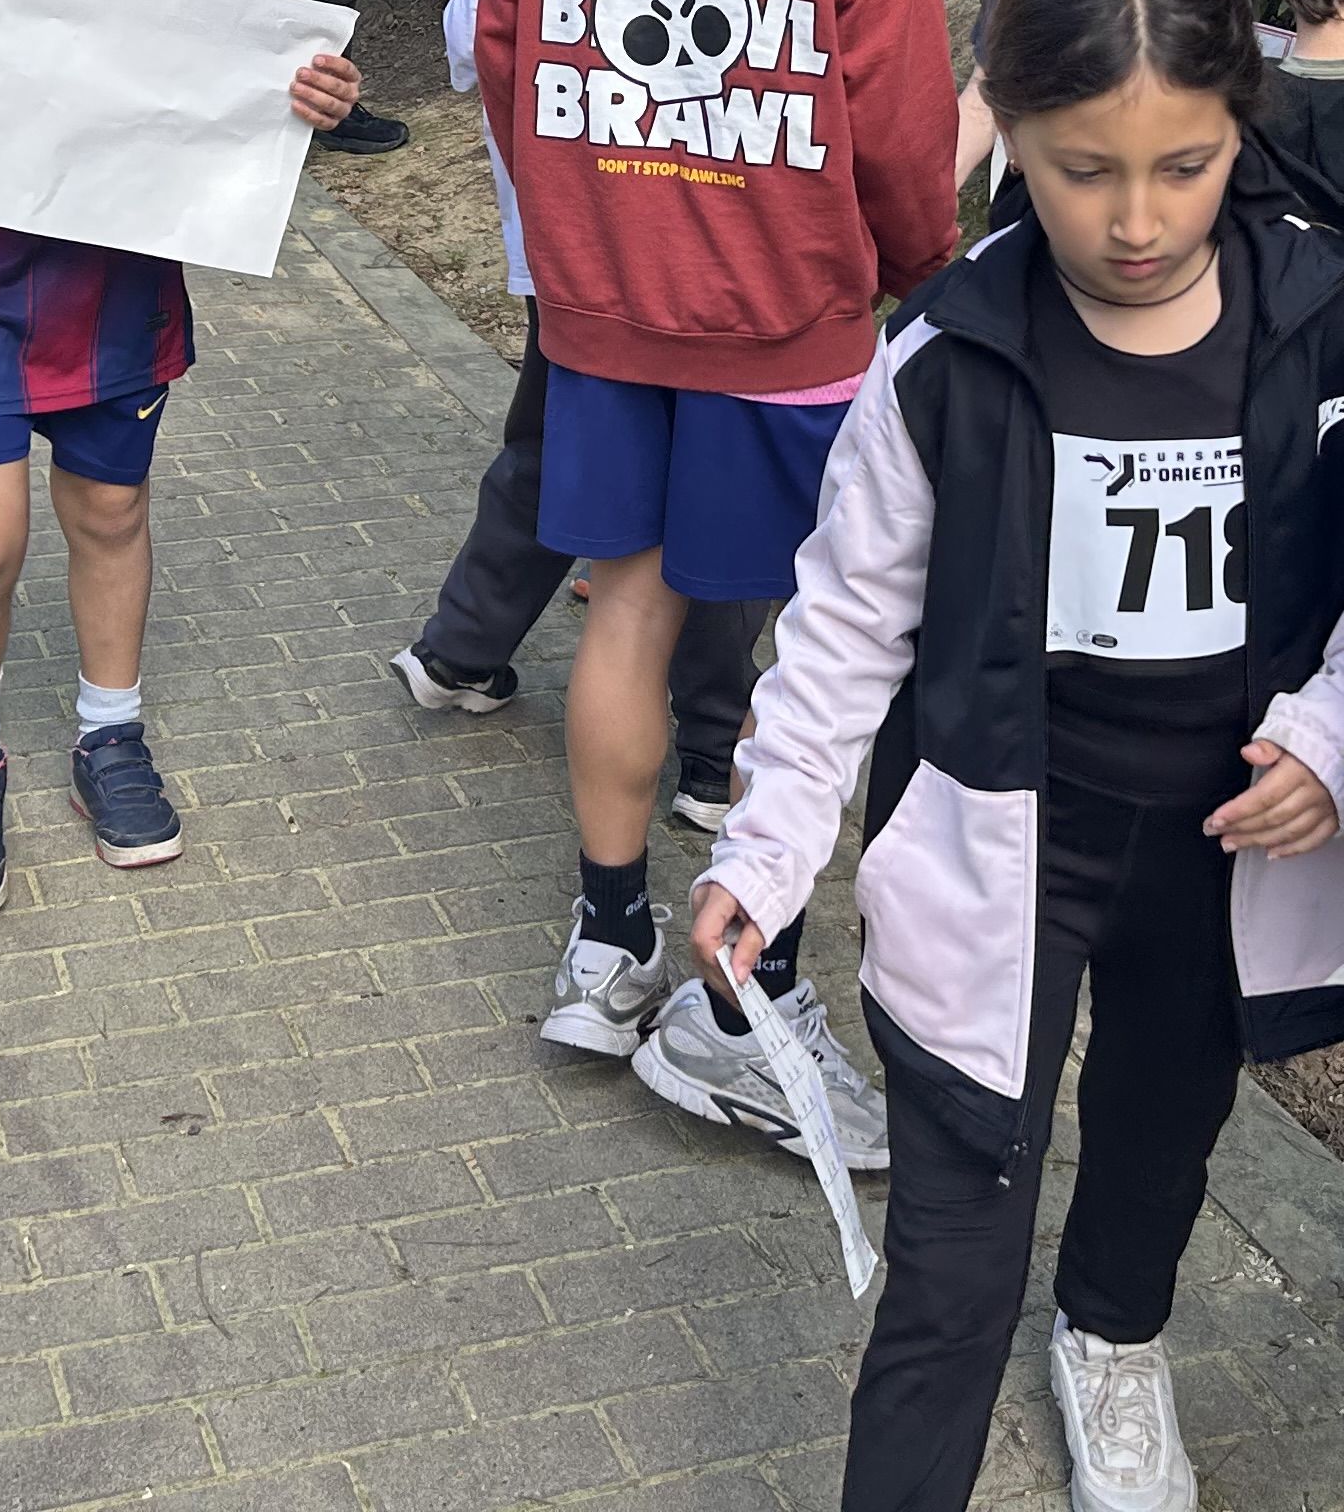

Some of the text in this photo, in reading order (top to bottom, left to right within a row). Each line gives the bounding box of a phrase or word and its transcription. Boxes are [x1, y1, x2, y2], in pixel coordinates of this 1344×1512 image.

[535, 62, 828, 170] BRAWL
[598, 158, 641, 175] DON'T
[642, 162, 679, 177] STOP
[1138, 450, 1222, 463] CURSA
